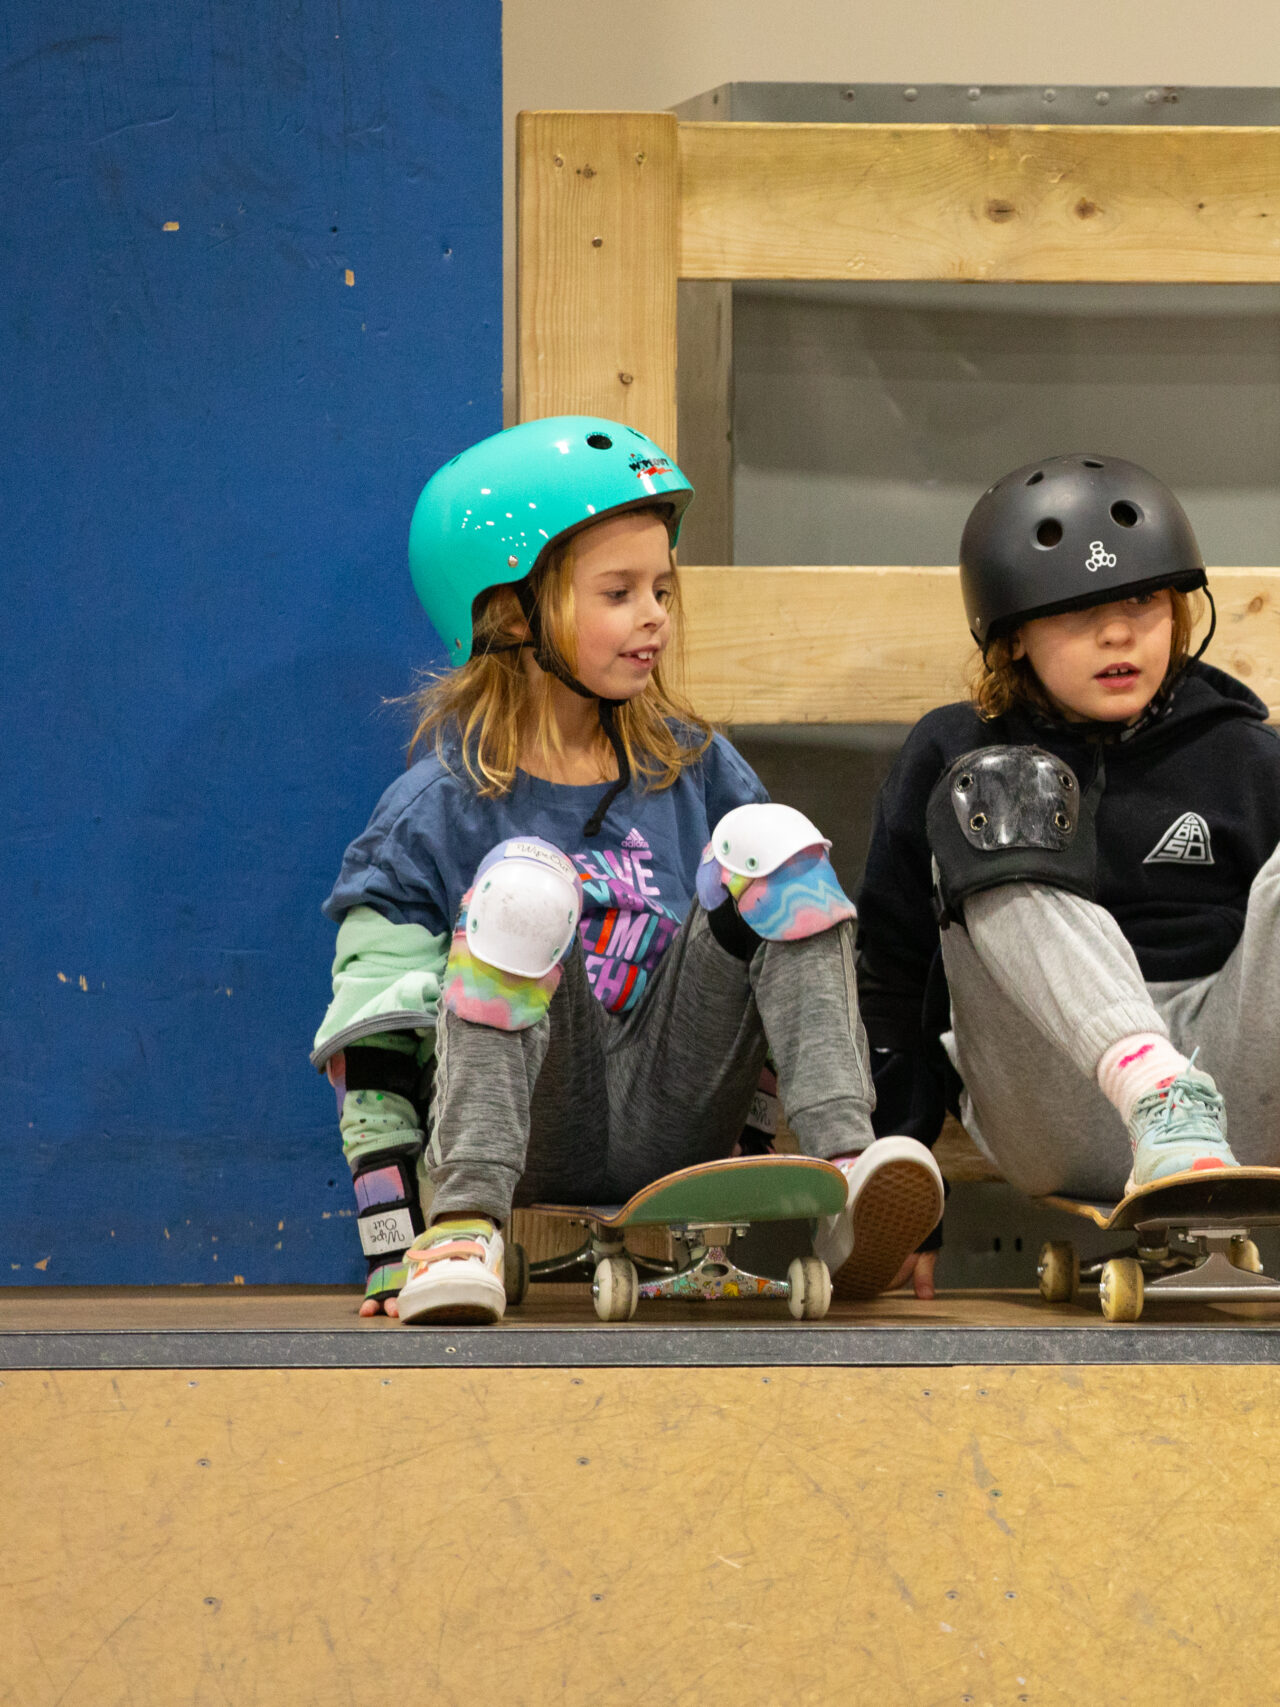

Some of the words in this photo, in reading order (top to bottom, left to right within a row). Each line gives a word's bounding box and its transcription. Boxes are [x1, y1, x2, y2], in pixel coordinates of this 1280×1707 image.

[516, 844, 549, 859] Wipe
[621, 840, 650, 849] adidas
[372, 1217, 397, 1231] Out
[369, 1229, 406, 1245] Wipe
